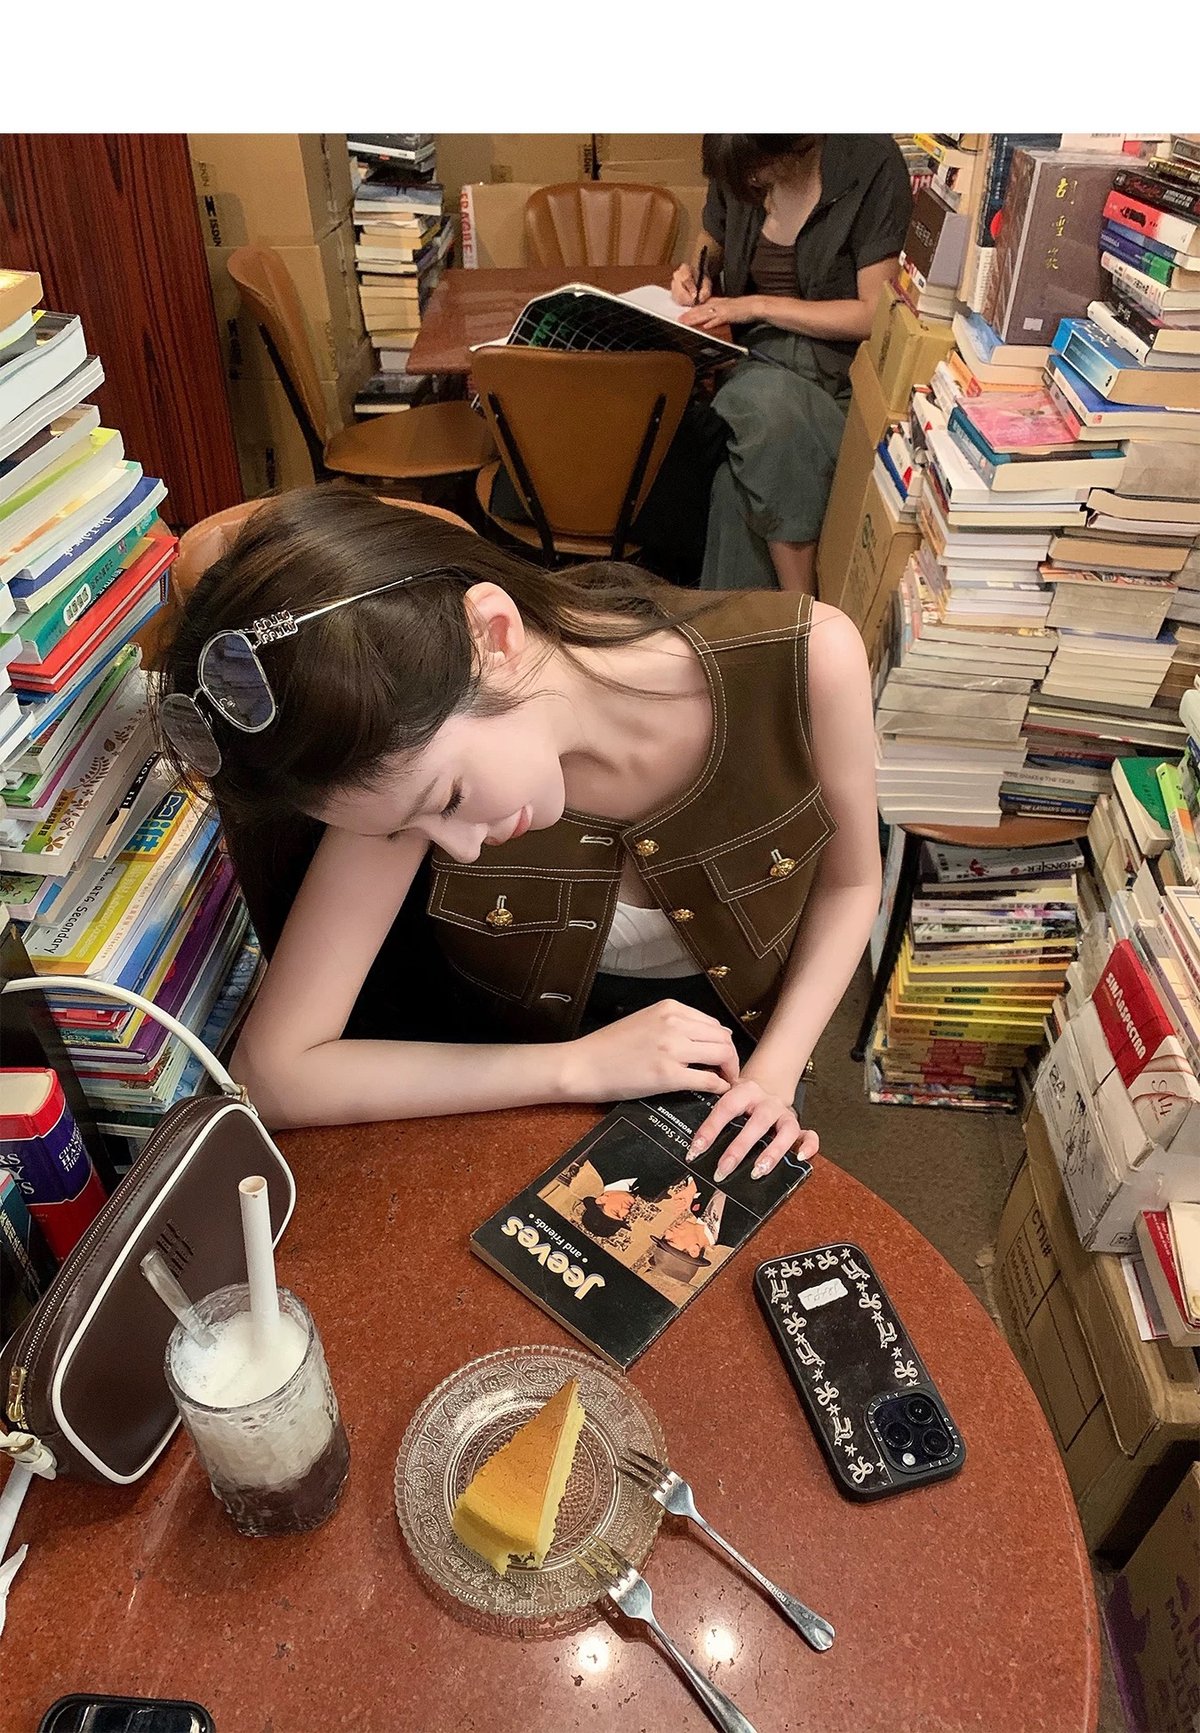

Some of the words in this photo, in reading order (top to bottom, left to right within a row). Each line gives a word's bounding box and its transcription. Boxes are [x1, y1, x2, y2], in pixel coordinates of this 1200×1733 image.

[44, 906, 88, 954] Secondary
[648, 1114, 677, 1138] Stories
[657, 1106, 693, 1135] WODEHOUSE
[534, 1218, 565, 1246] Friends
[563, 1242, 583, 1258] and
[501, 1216, 606, 1300] Jeeves
[868, 1392, 899, 1442] CASETIFY
[928, 1417, 960, 1468] CASETIFY
